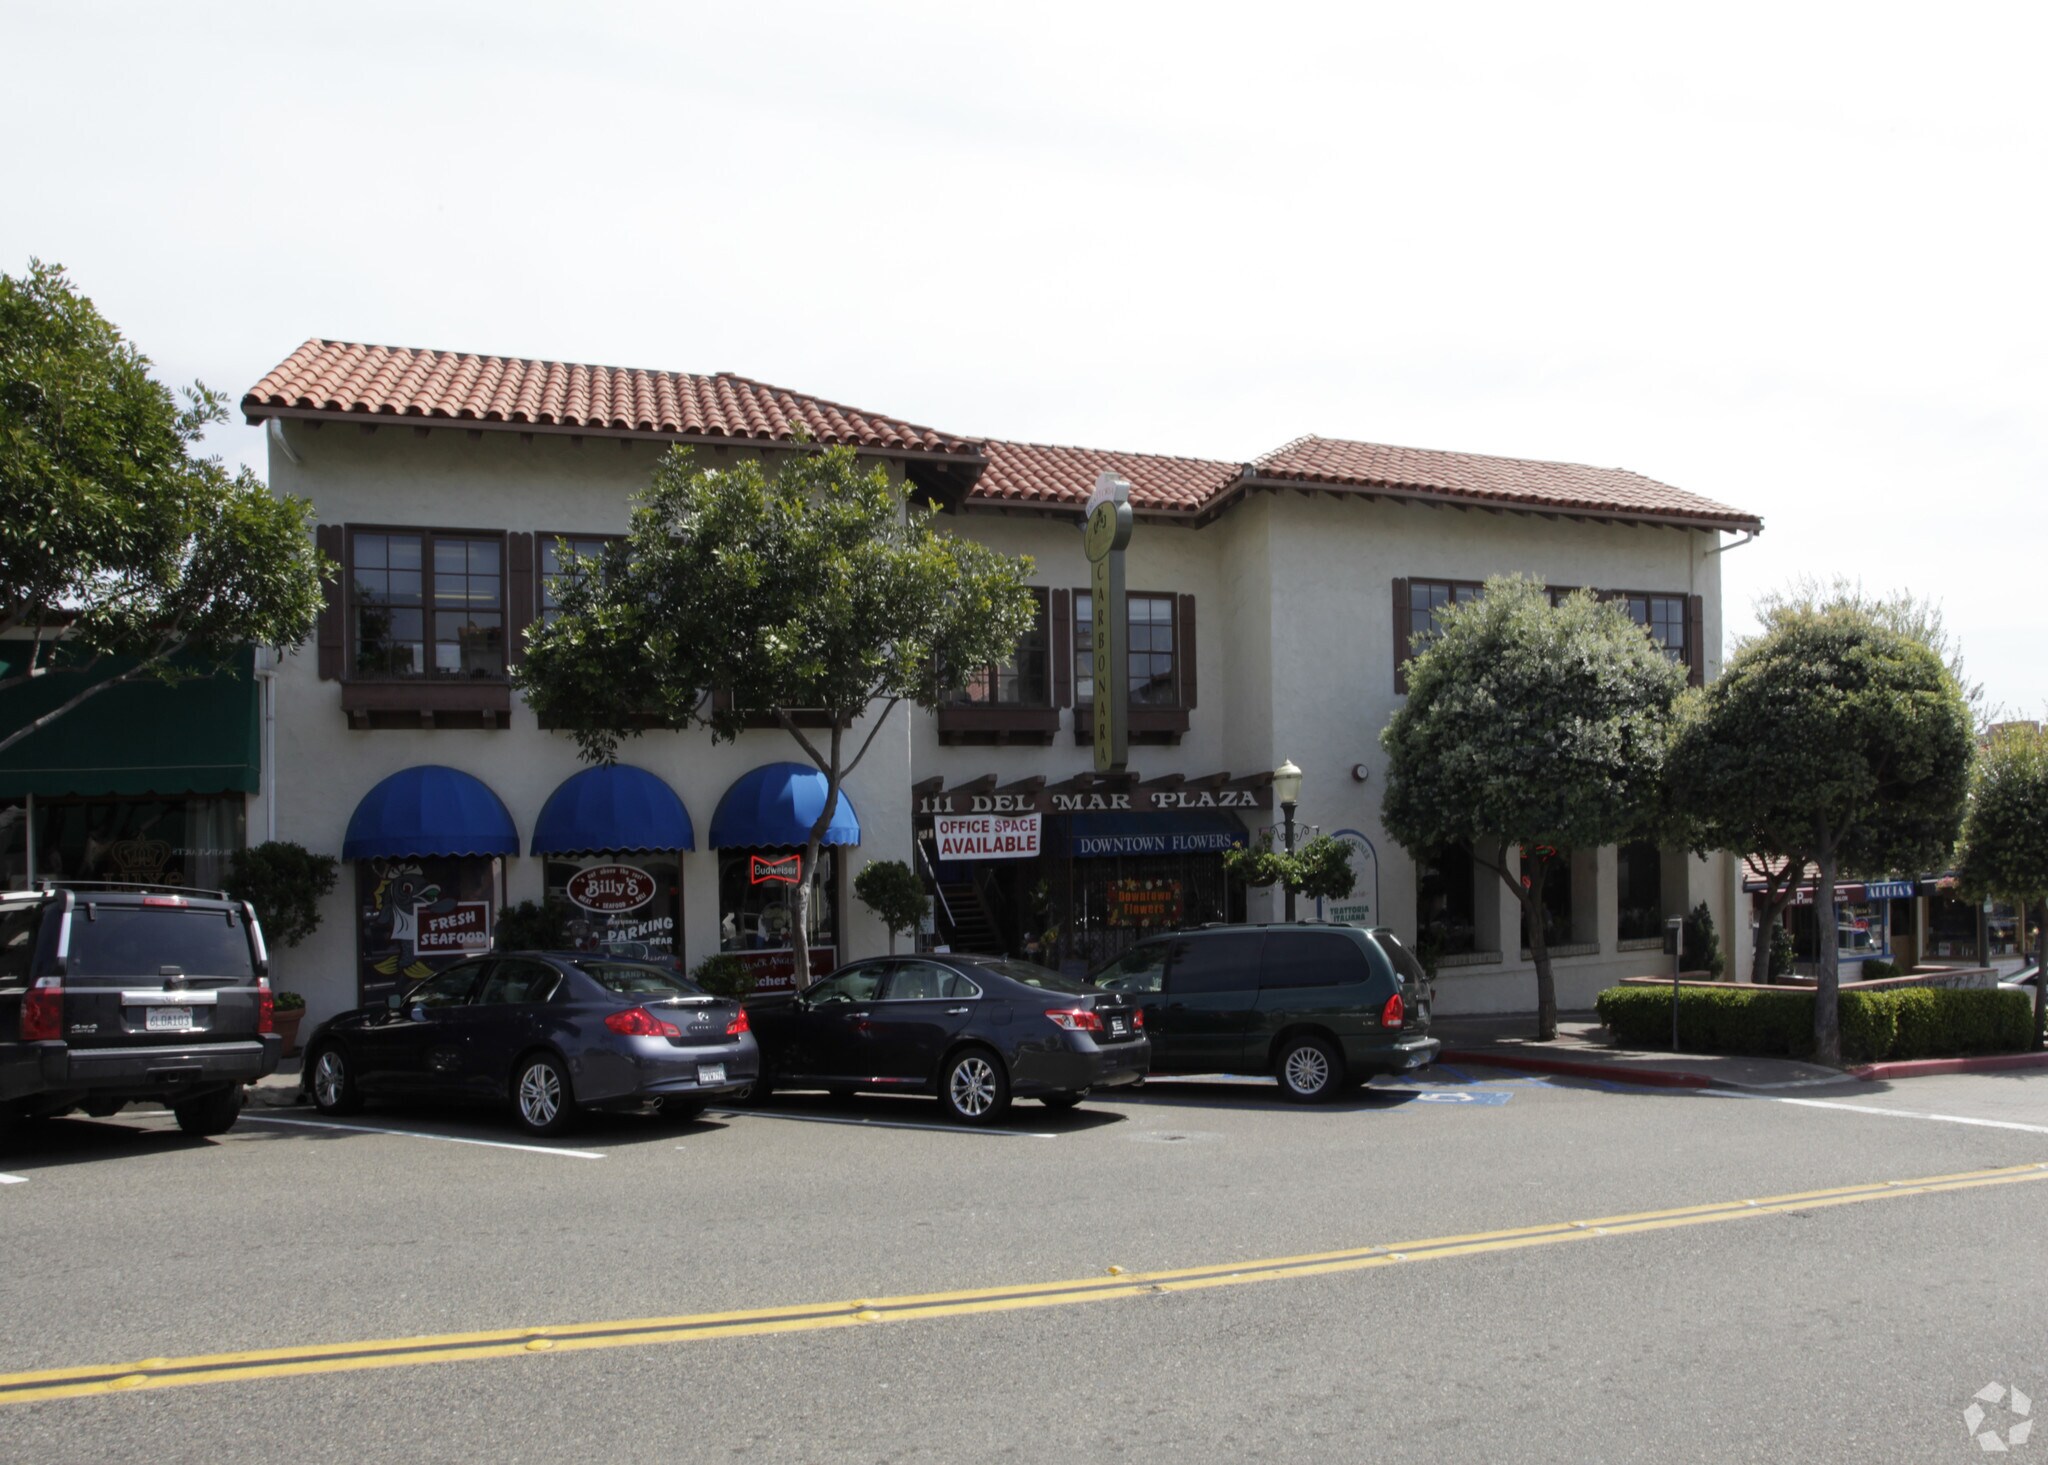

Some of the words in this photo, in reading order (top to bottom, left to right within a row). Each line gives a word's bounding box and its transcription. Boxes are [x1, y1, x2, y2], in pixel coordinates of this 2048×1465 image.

[1096, 562, 1107, 763] CARBONARA
[920, 797, 954, 814] 111
[971, 794, 1035, 812] DEL
[1052, 793, 1131, 810] MAR
[1151, 791, 1259, 808] PLAZA
[940, 820, 990, 834] OFFICE
[995, 818, 1037, 833] SPACE
[941, 835, 1037, 855] AVAILABLE
[1081, 836, 1165, 853] DOWNTOWN
[1173, 834, 1231, 850] FLOWERS
[754, 864, 797, 876] Budweiser
[1119, 891, 1171, 902] Downtown
[1869, 884, 1912, 898] ALICIA'S
[1124, 904, 1164, 914] Flowers
[1330, 905, 1369, 915] TRATTORIA
[429, 911, 476, 931] FRESH
[1334, 913, 1365, 922] ITALIANA
[608, 917, 673, 942] PARKING
[421, 932, 486, 945] SEAFOOD
[650, 937, 672, 945] REAR
